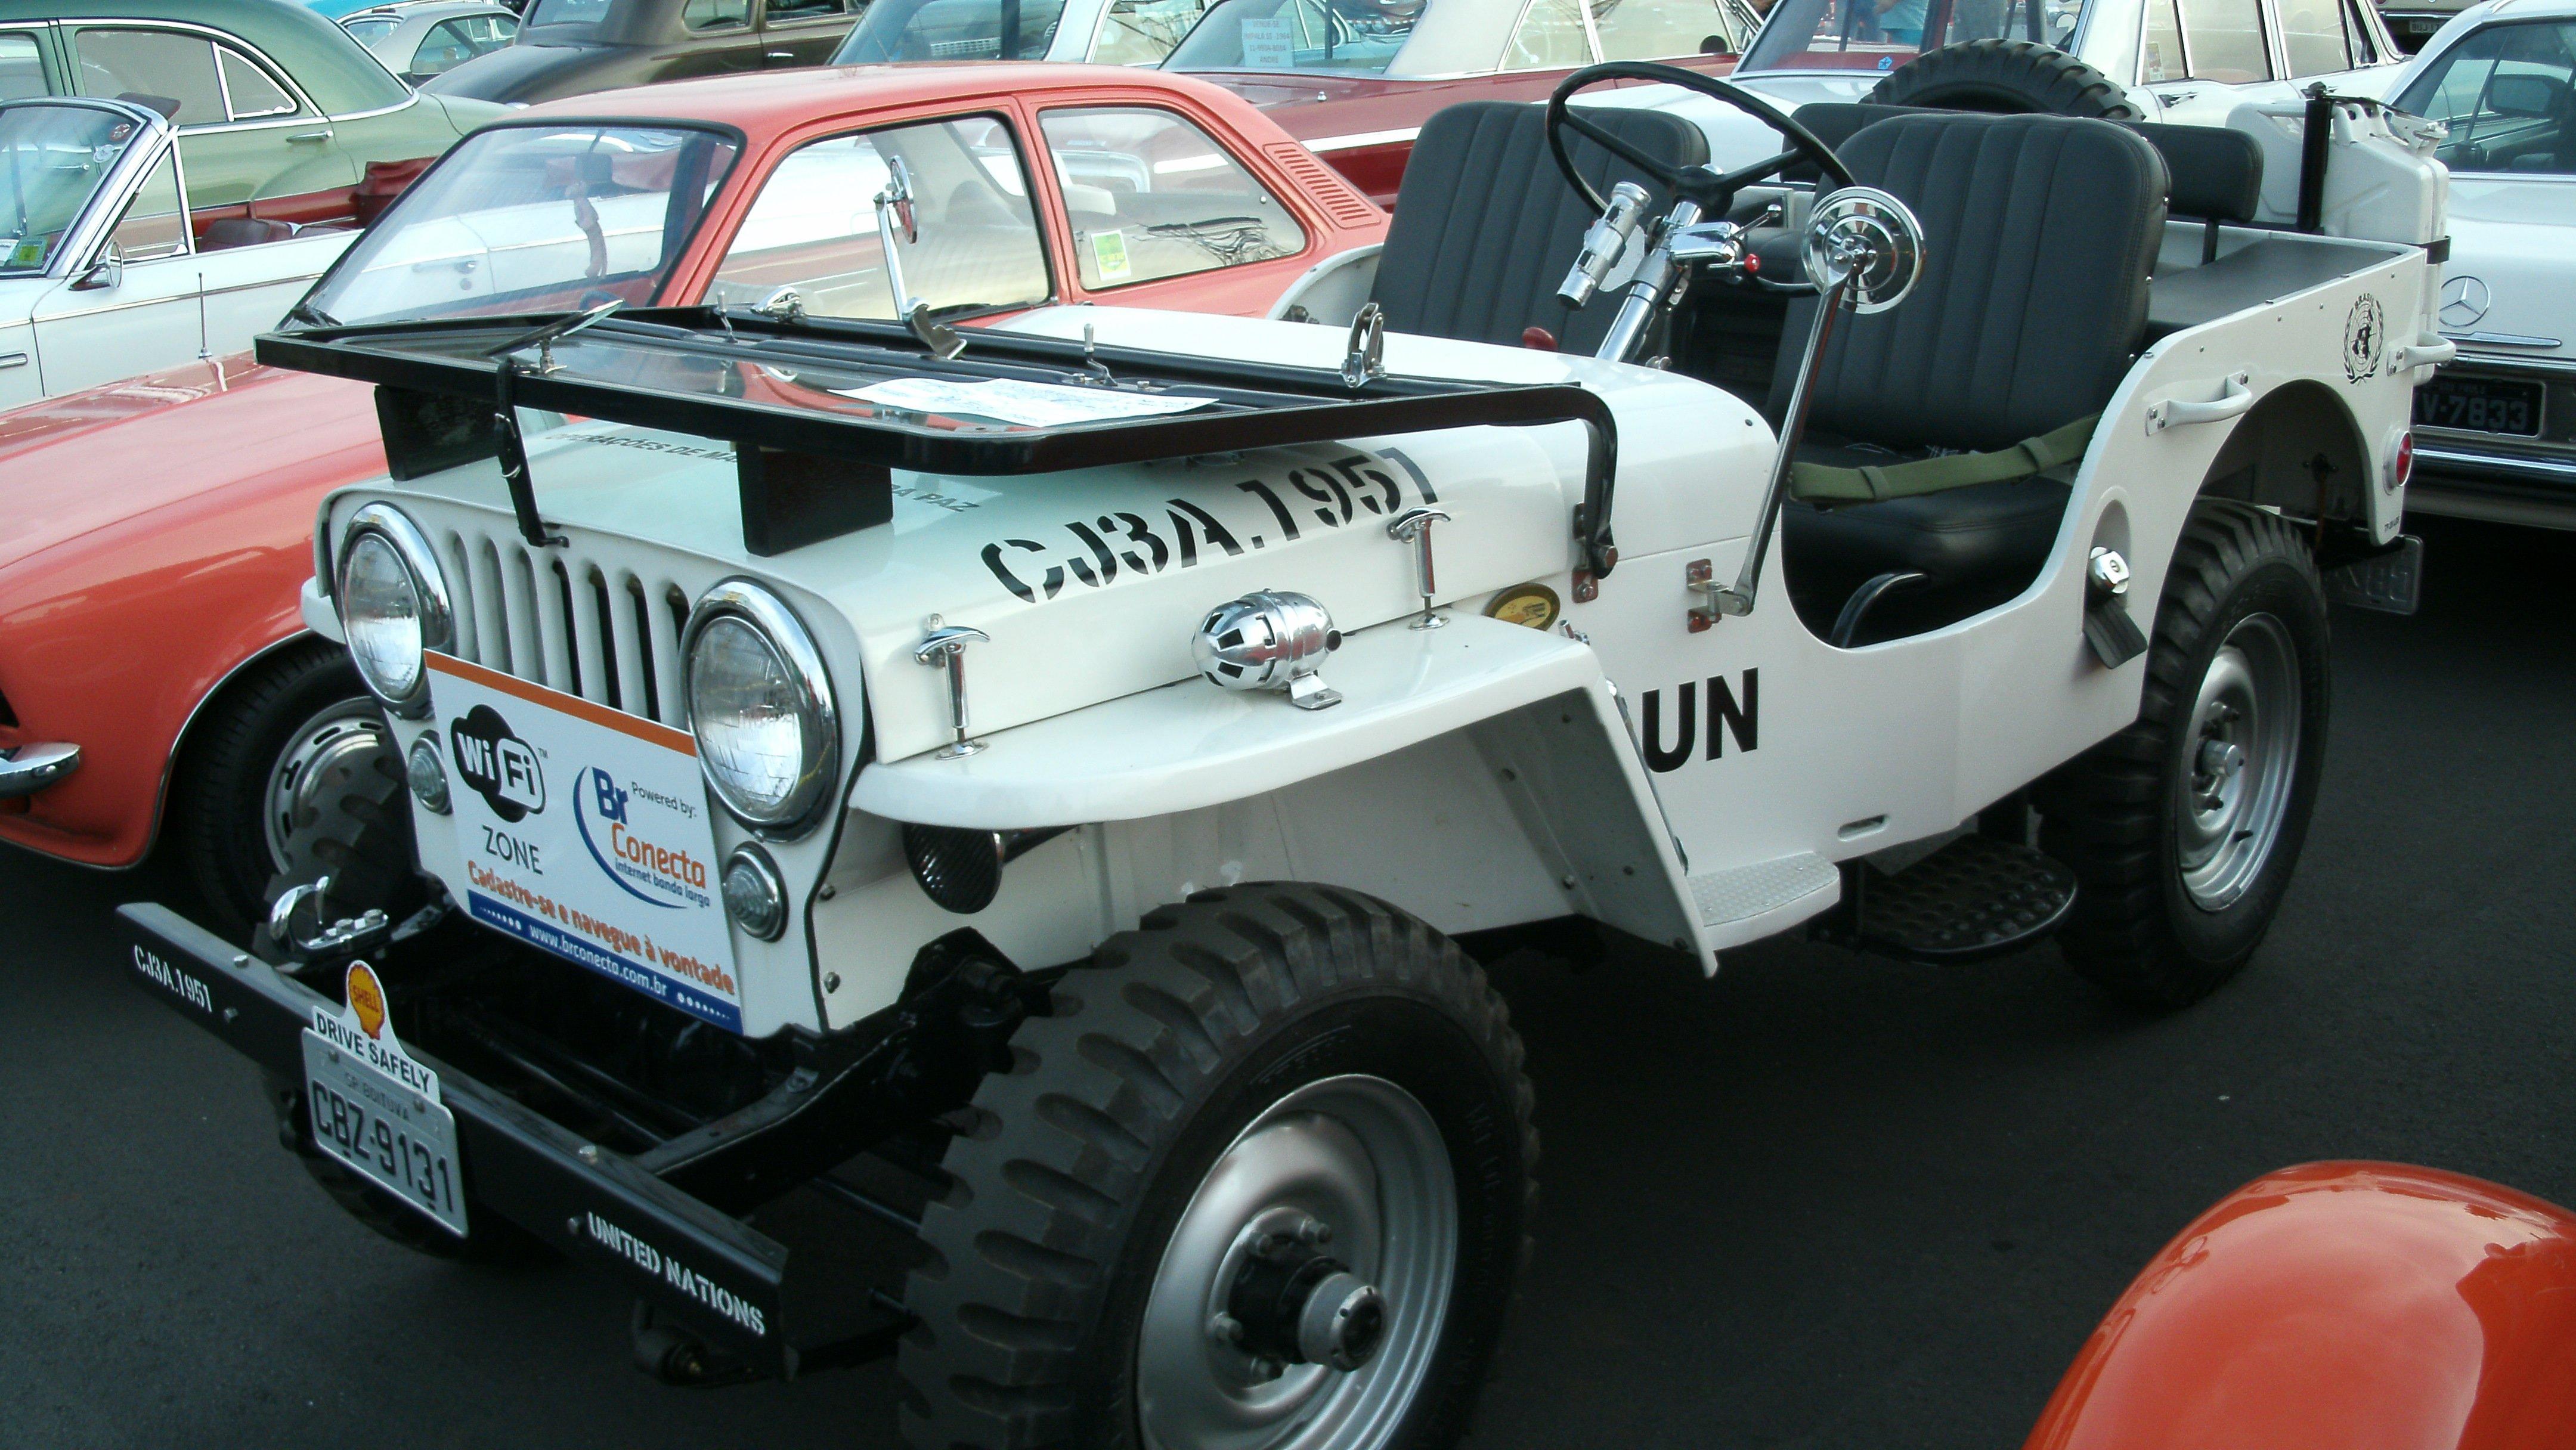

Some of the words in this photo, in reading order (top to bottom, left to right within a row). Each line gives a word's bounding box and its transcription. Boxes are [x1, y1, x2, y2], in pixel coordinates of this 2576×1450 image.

[664, 445, 706, 456] DE
[912, 492, 980, 512] PAZ
[980, 447, 1439, 603] CJ3A.1951
[1642, 667, 1758, 773] UN
[591, 766, 629, 825] Br
[631, 782, 679, 811] Powered
[680, 801, 698, 819] by:
[482, 825, 544, 875] ZONE
[611, 823, 707, 890] Conecta
[615, 857, 652, 884] internet
[652, 875, 683, 897] banda
[685, 885, 710, 908] larga
[467, 860, 557, 919] Cadastre-se
[559, 903, 569, 925] e
[571, 909, 643, 957] navegue
[645, 934, 657, 962] à
[658, 945, 735, 996] vontade
[528, 924, 669, 998] www.brconecta.com.br
[134, 944, 213, 1014] CJ3A.1951
[352, 983, 382, 1014] SHELL
[316, 1012, 366, 1056] DRIVE
[368, 1040, 431, 1094] SAFELY
[586, 1210, 661, 1275] UNITED
[664, 1255, 766, 1336] NATIONS
